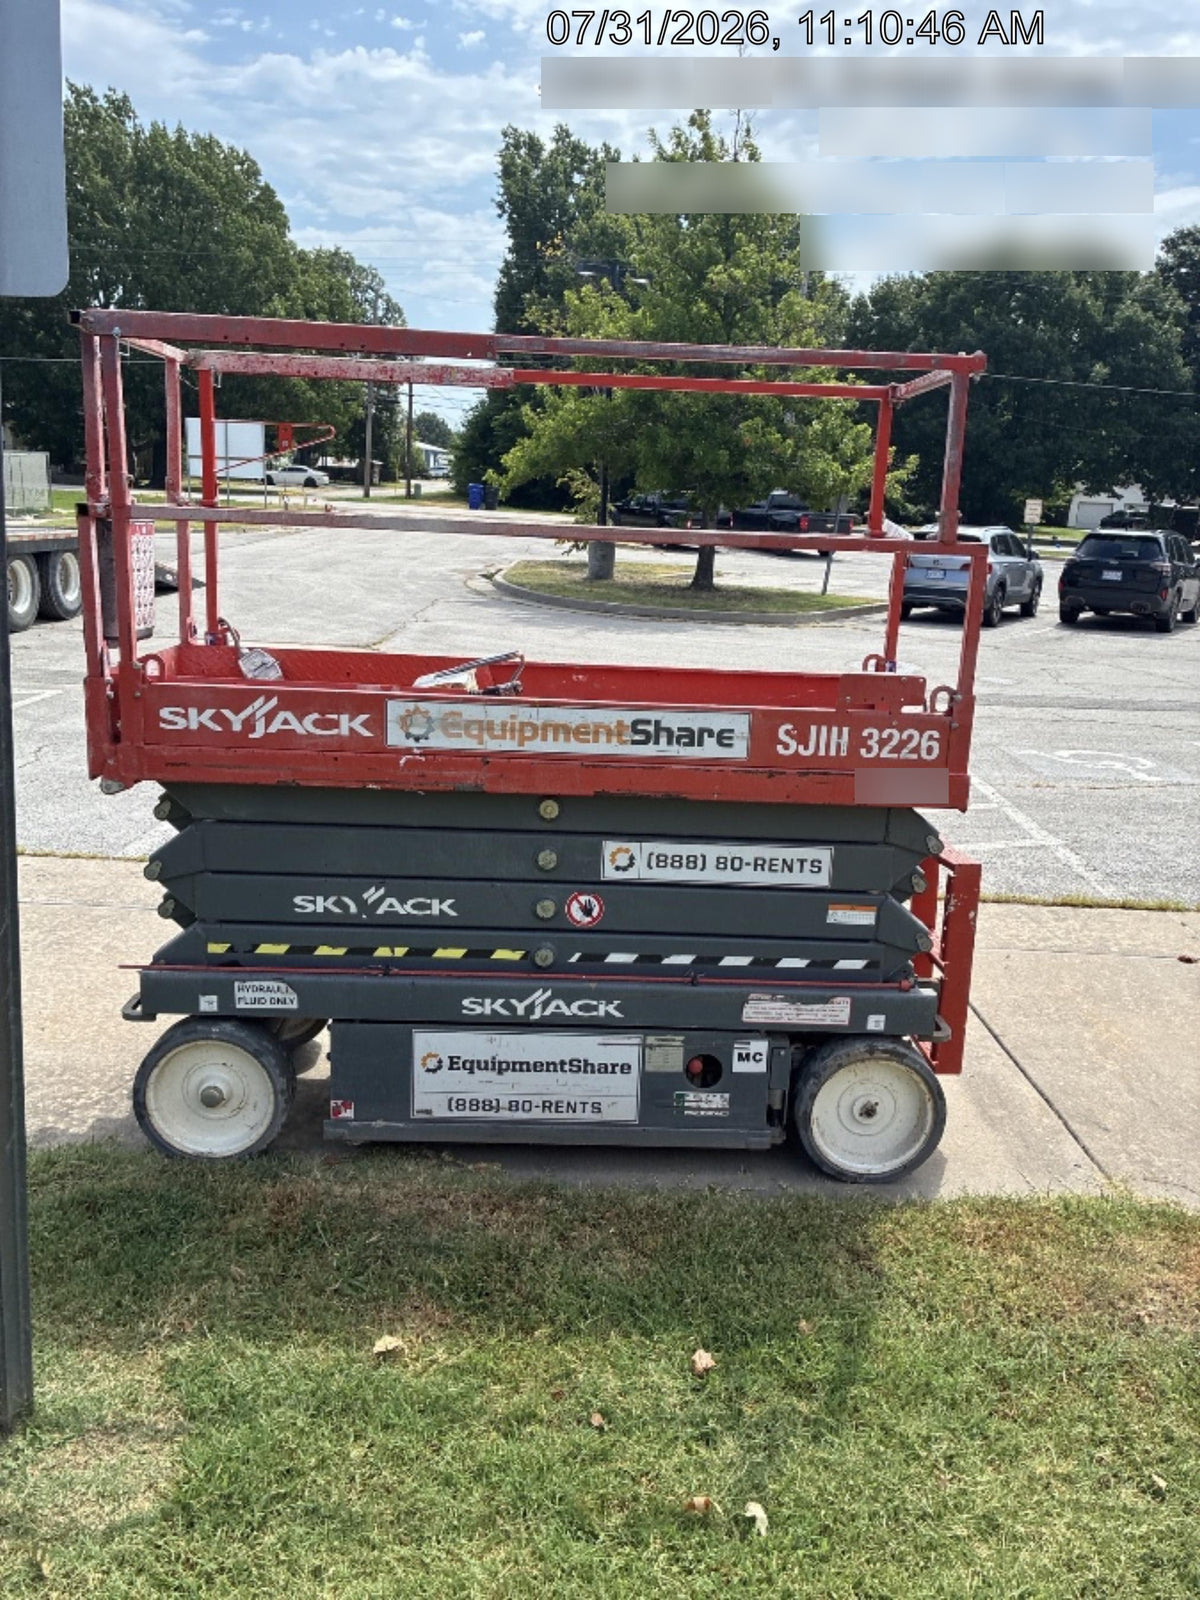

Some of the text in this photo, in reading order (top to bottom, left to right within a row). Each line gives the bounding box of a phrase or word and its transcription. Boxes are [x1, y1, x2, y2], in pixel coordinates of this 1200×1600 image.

[159, 695, 375, 739] SKYJACK
[440, 711, 736, 748] EquipmentShare
[860, 726, 941, 760] 3226
[646, 852, 823, 874] (888) 80-RENTS
[237, 996, 296, 1005] FLUID ONLY
[461, 988, 625, 1020] SKYJACK
[447, 1055, 632, 1075] EquipmentShare
[737, 1052, 763, 1063] MC
[447, 1097, 501, 1112] (888)
[508, 1100, 602, 1114] 80-RENTS
